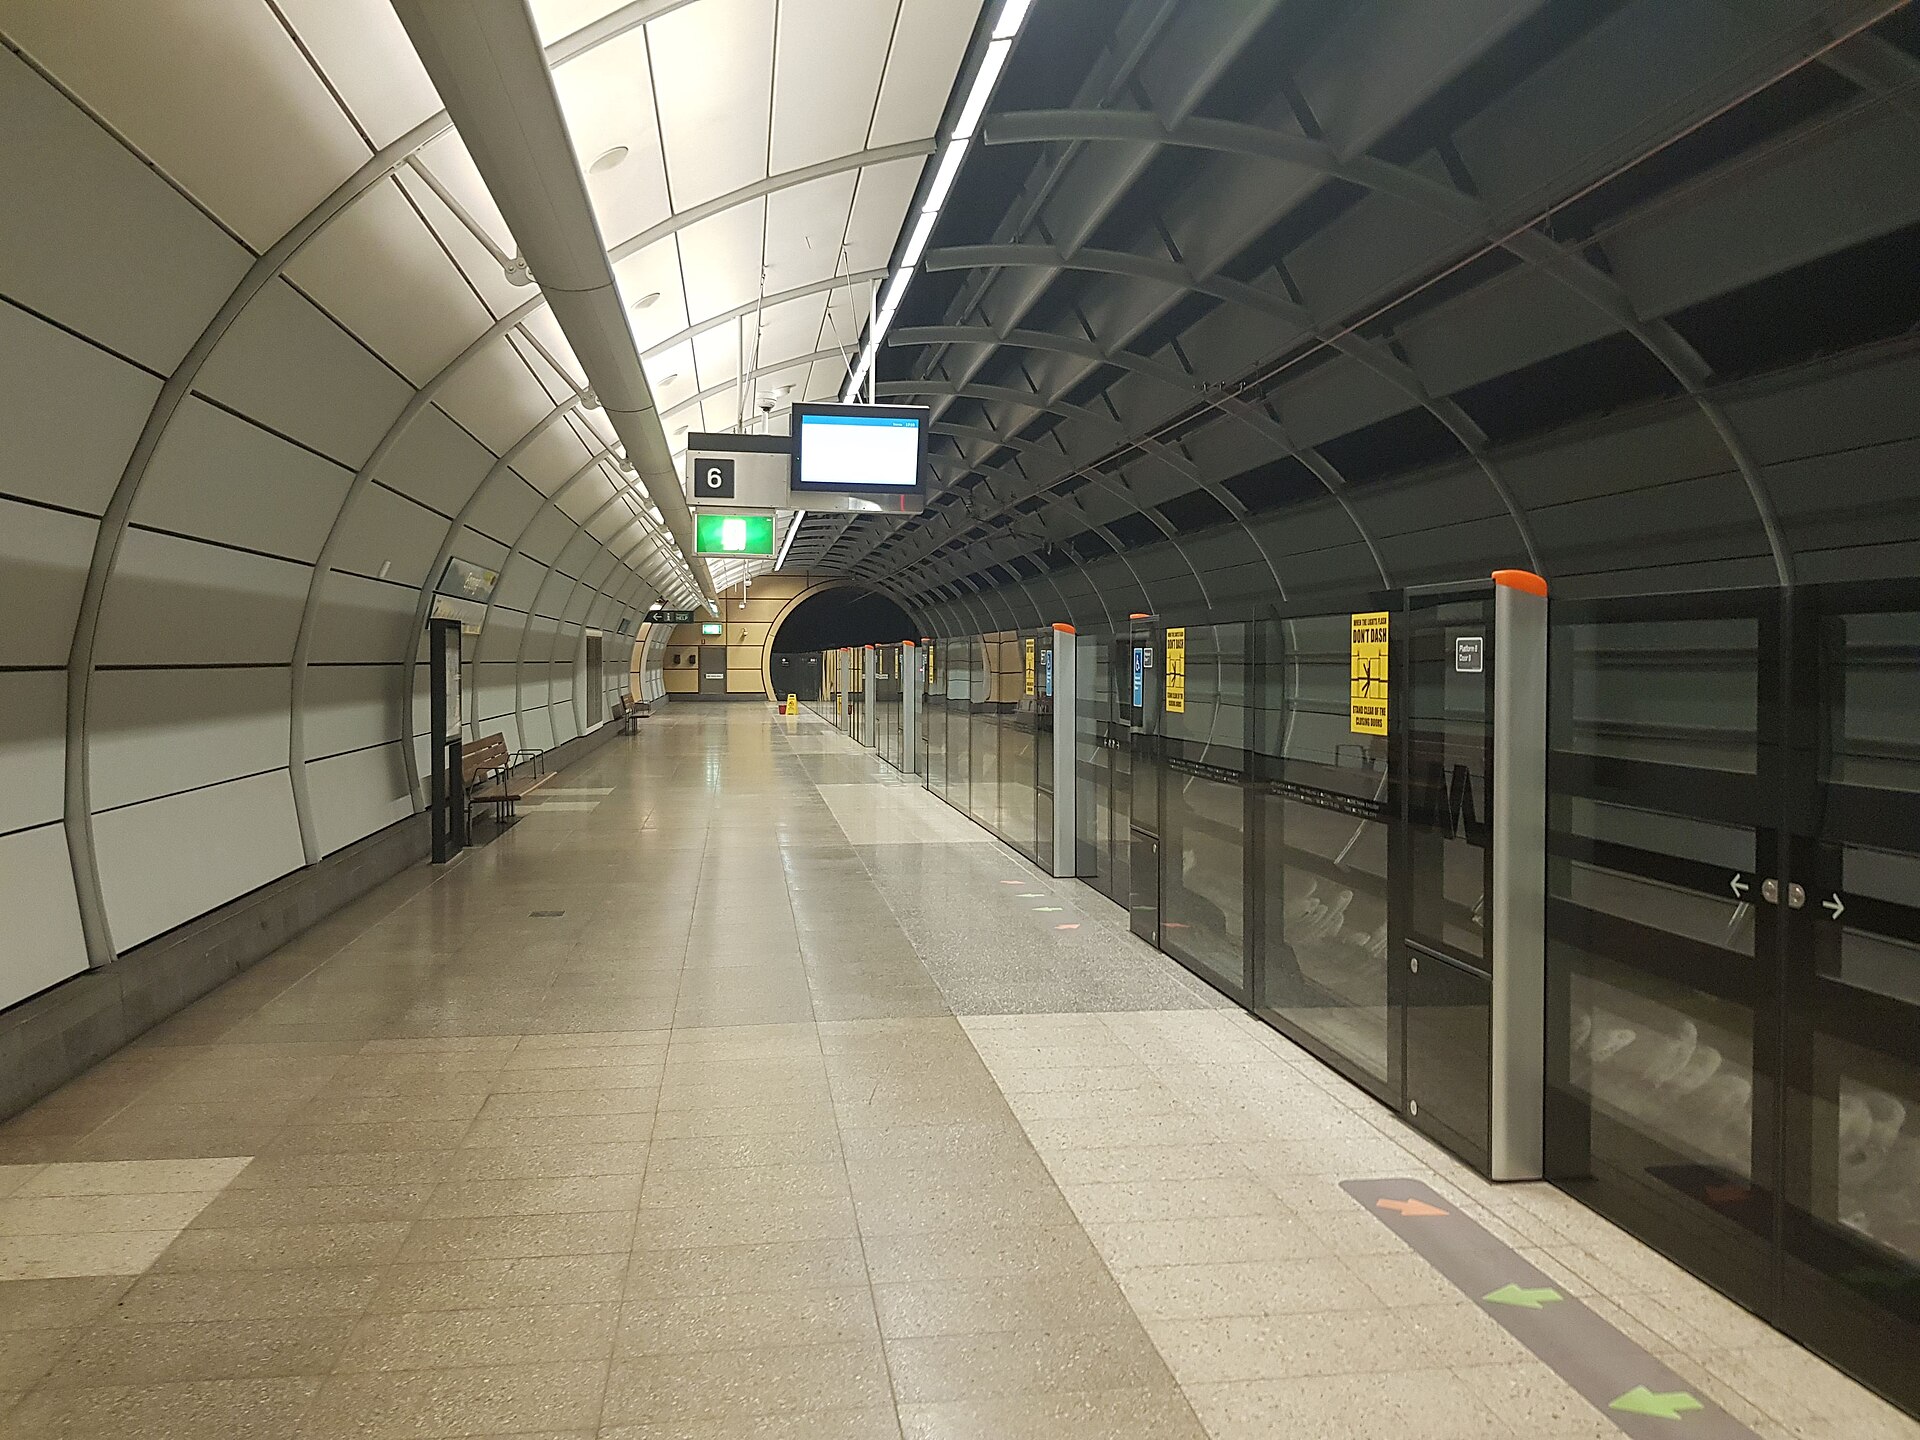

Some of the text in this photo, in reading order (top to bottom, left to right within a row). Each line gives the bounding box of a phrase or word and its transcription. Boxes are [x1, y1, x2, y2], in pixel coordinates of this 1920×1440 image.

[706, 467, 722, 489] 6
[1353, 627, 1387, 643] DON'T DASH
[1352, 705, 1363, 714] STAND
[1364, 706, 1374, 715] CLEAR
[1356, 716, 1383, 728] CLOSING DOORS
